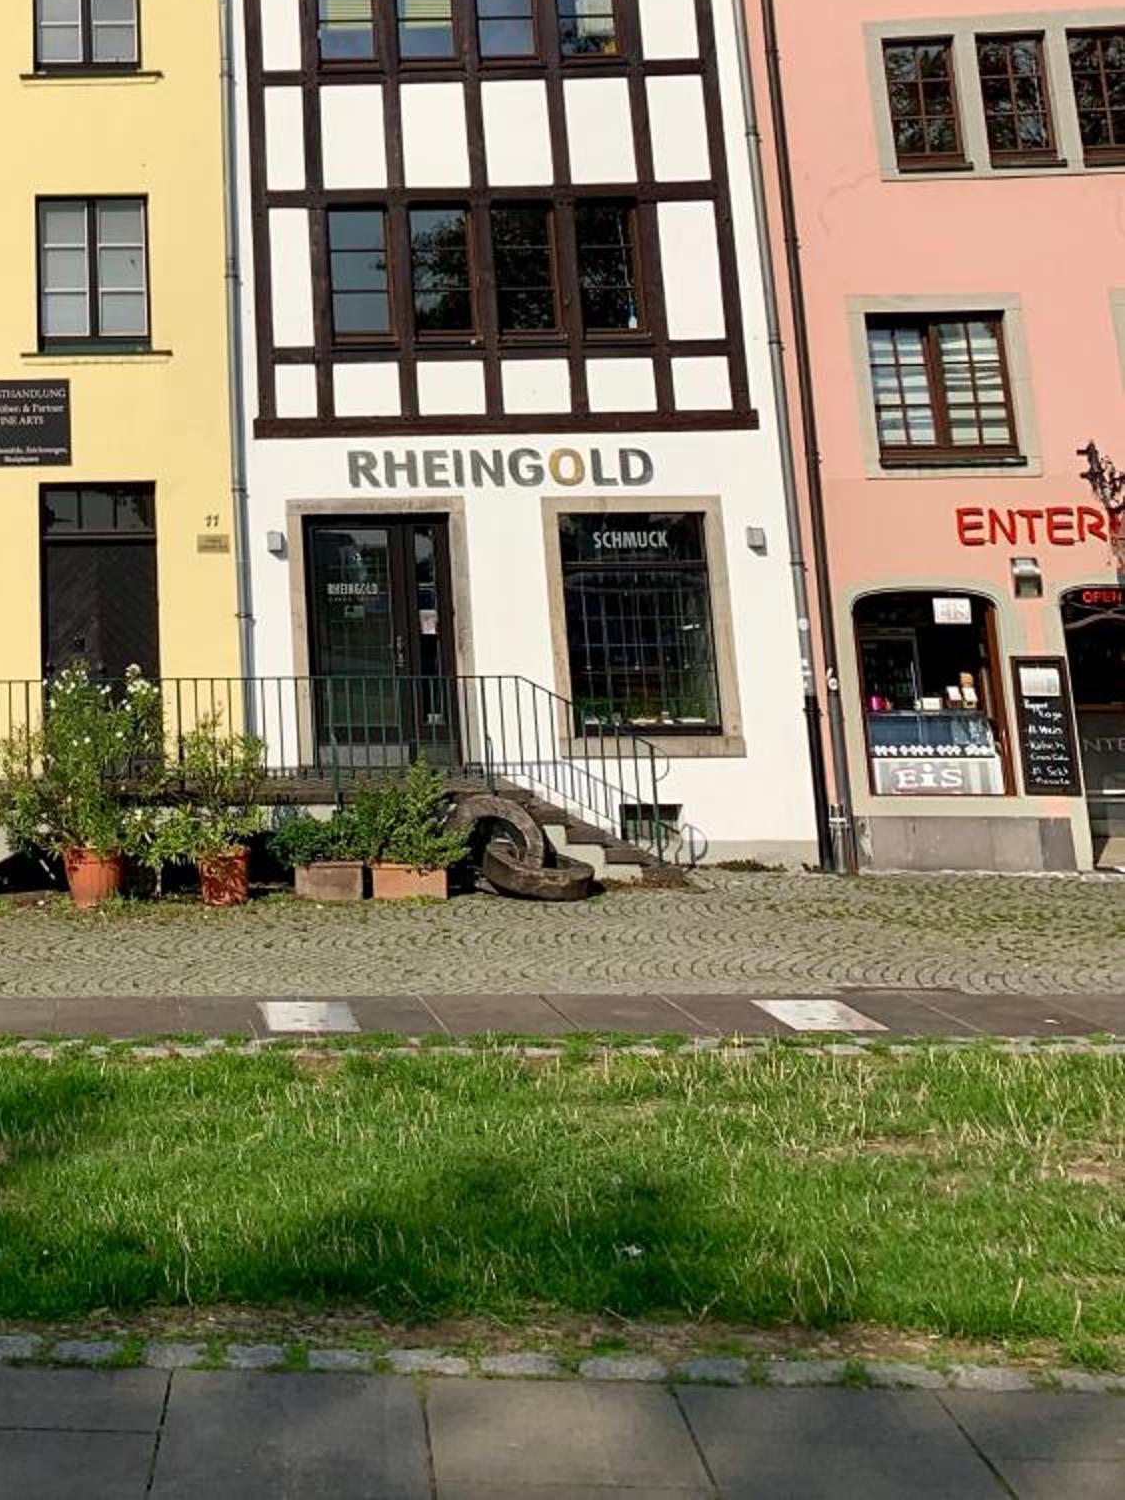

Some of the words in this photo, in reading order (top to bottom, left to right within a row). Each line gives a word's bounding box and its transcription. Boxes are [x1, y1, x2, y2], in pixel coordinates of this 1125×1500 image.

[32, 402, 64, 414] Partner
[18, 414, 44, 425] ARTS
[347, 447, 654, 488] RHEINGOLD
[593, 531, 668, 549] SCHMUCK
[1082, 591, 1122, 603] OPEN
